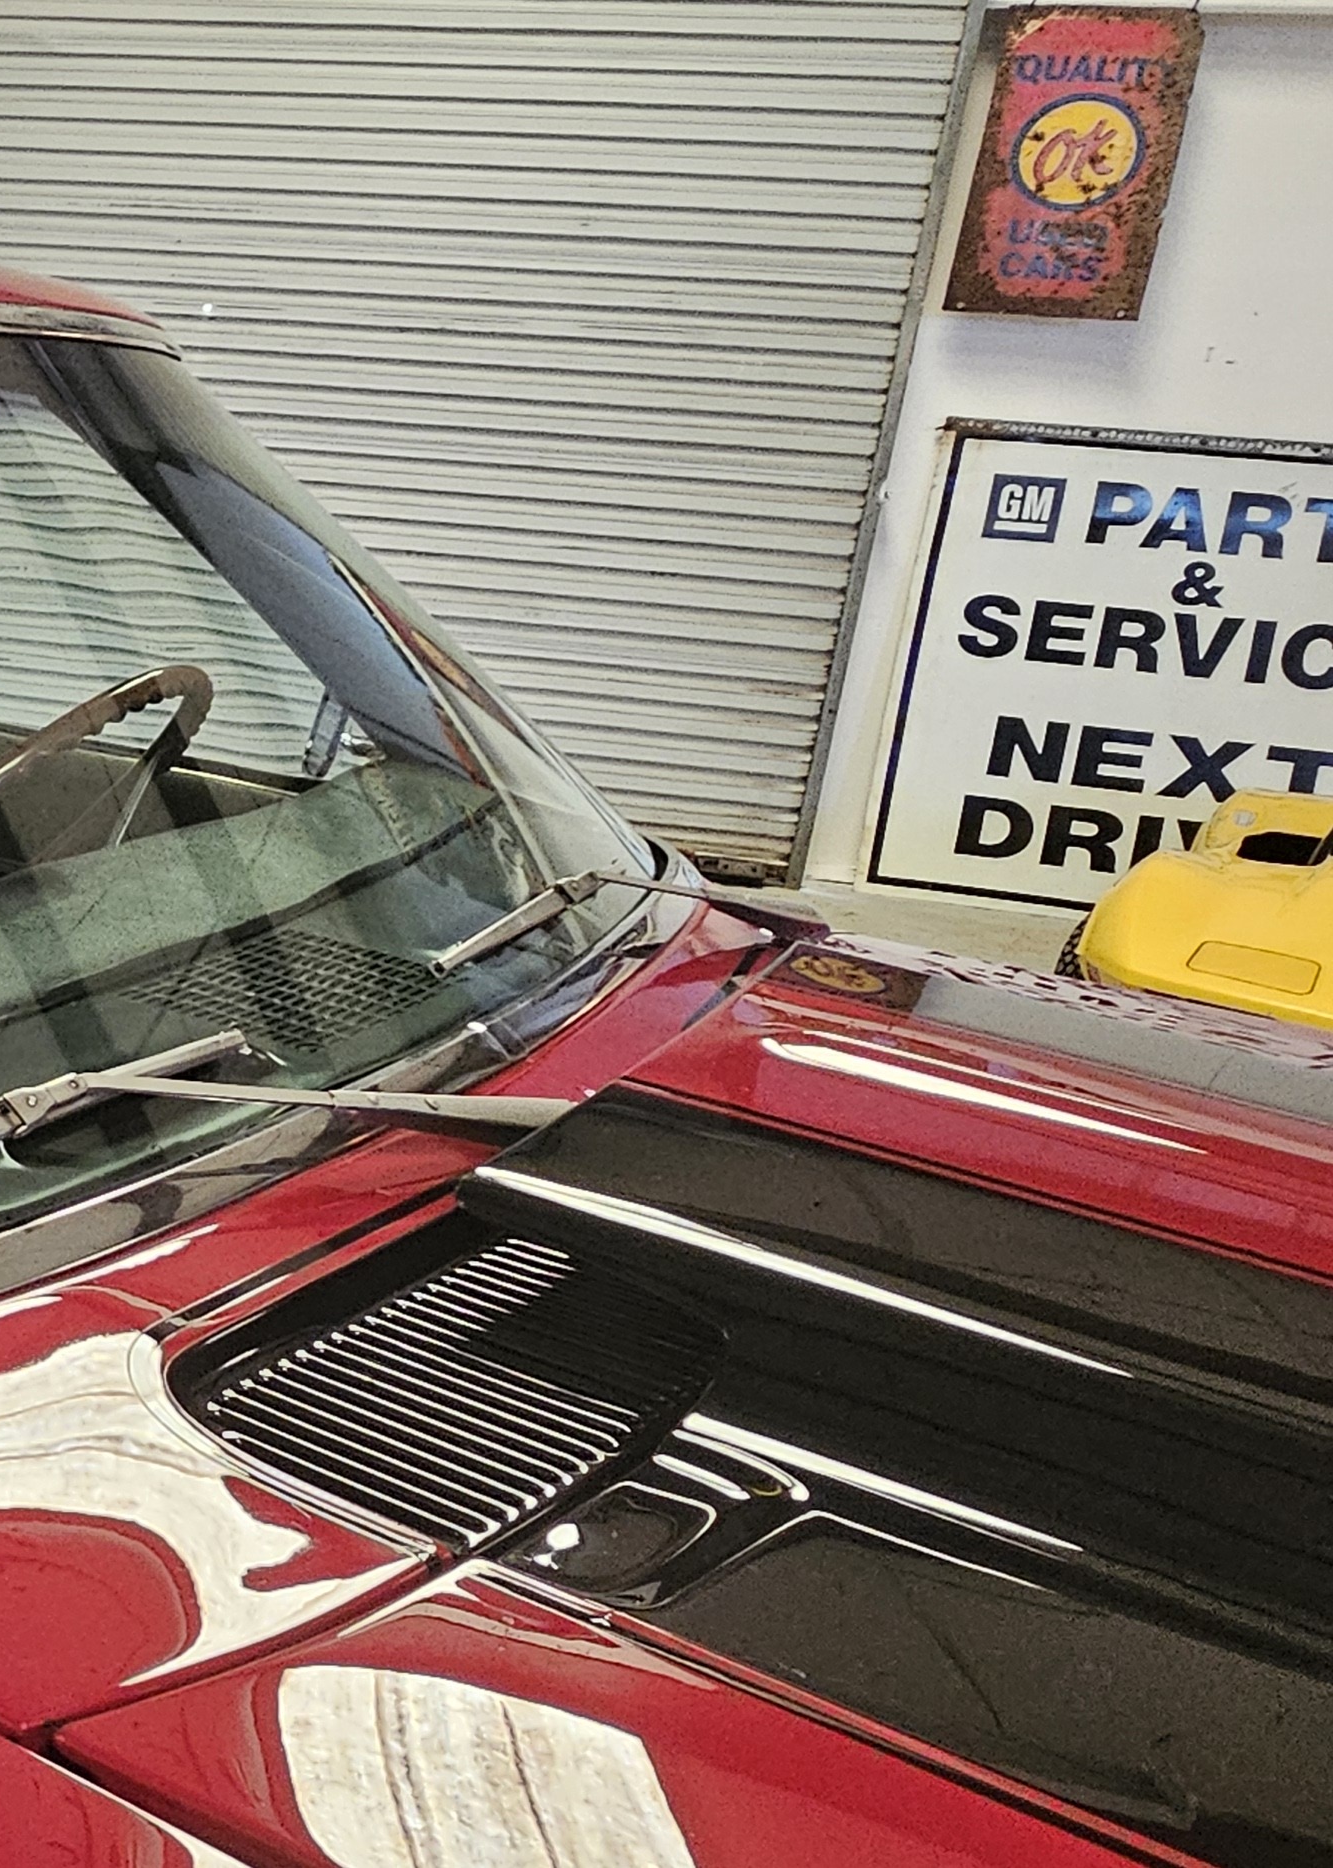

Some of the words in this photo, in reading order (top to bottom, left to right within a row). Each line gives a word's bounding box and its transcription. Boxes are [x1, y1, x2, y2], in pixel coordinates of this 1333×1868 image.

[1033, 118, 1118, 185] OK
[998, 483, 1057, 523] GM
[1171, 561, 1224, 608] &
[958, 594, 1333, 690] SERVIC
[986, 715, 1333, 803] NEXT
